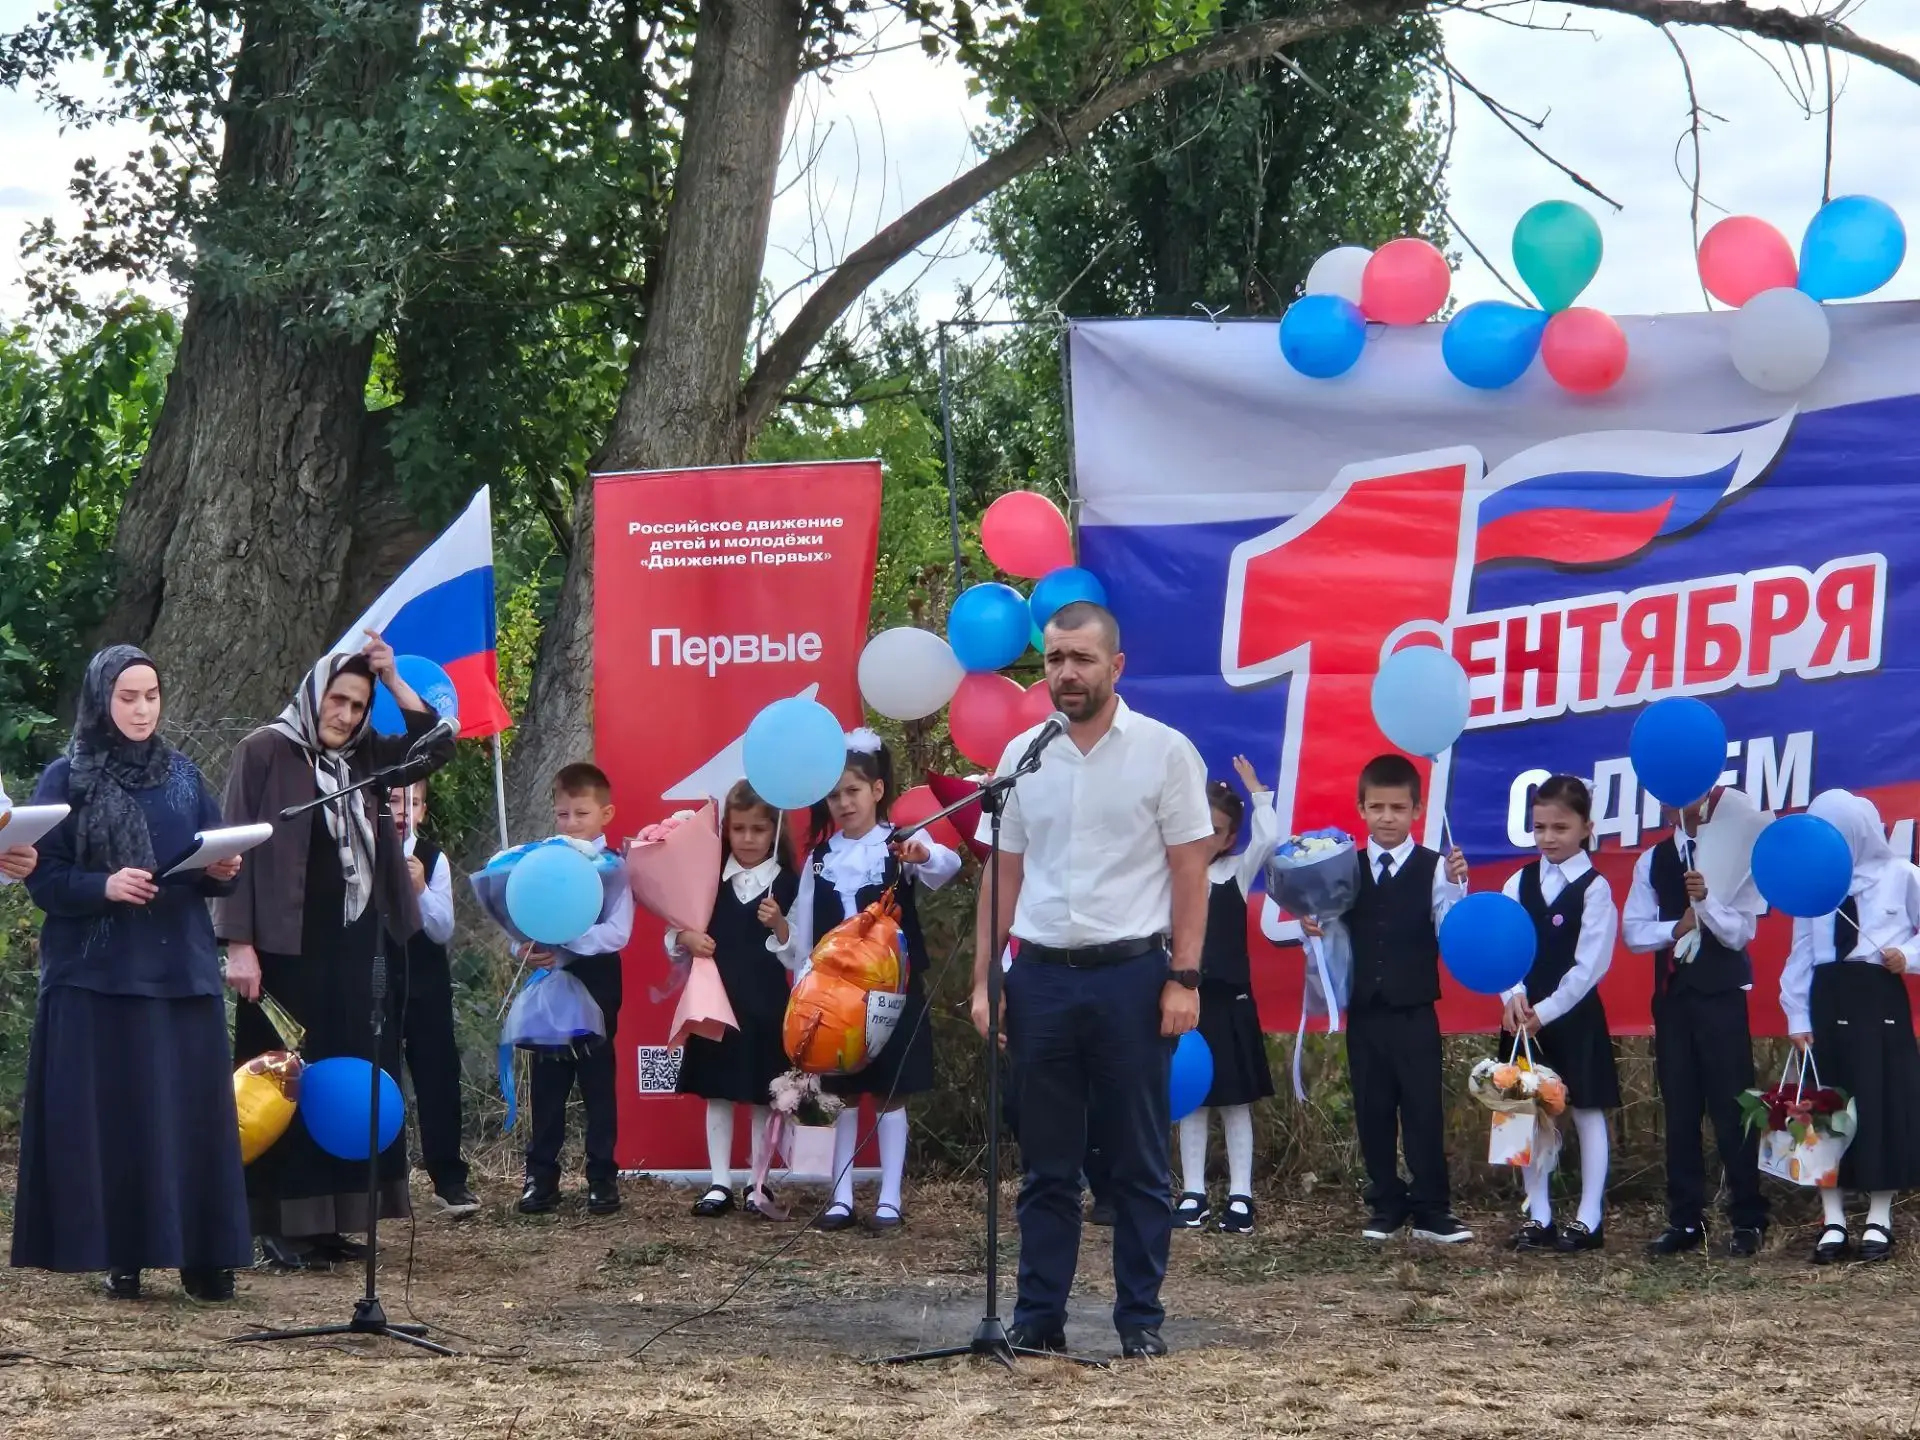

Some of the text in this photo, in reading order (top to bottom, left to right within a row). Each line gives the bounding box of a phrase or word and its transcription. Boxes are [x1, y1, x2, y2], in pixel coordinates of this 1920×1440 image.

[628, 516, 844, 535] Российское движение
[640, 550, 832, 570] «Движение Первых»
[649, 534, 824, 553] детей и молодёжи
[651, 628, 823, 678] Первые
[1384, 558, 1883, 723] ЕНТЯБРЯ
[1590, 731, 1814, 852] ДМ
